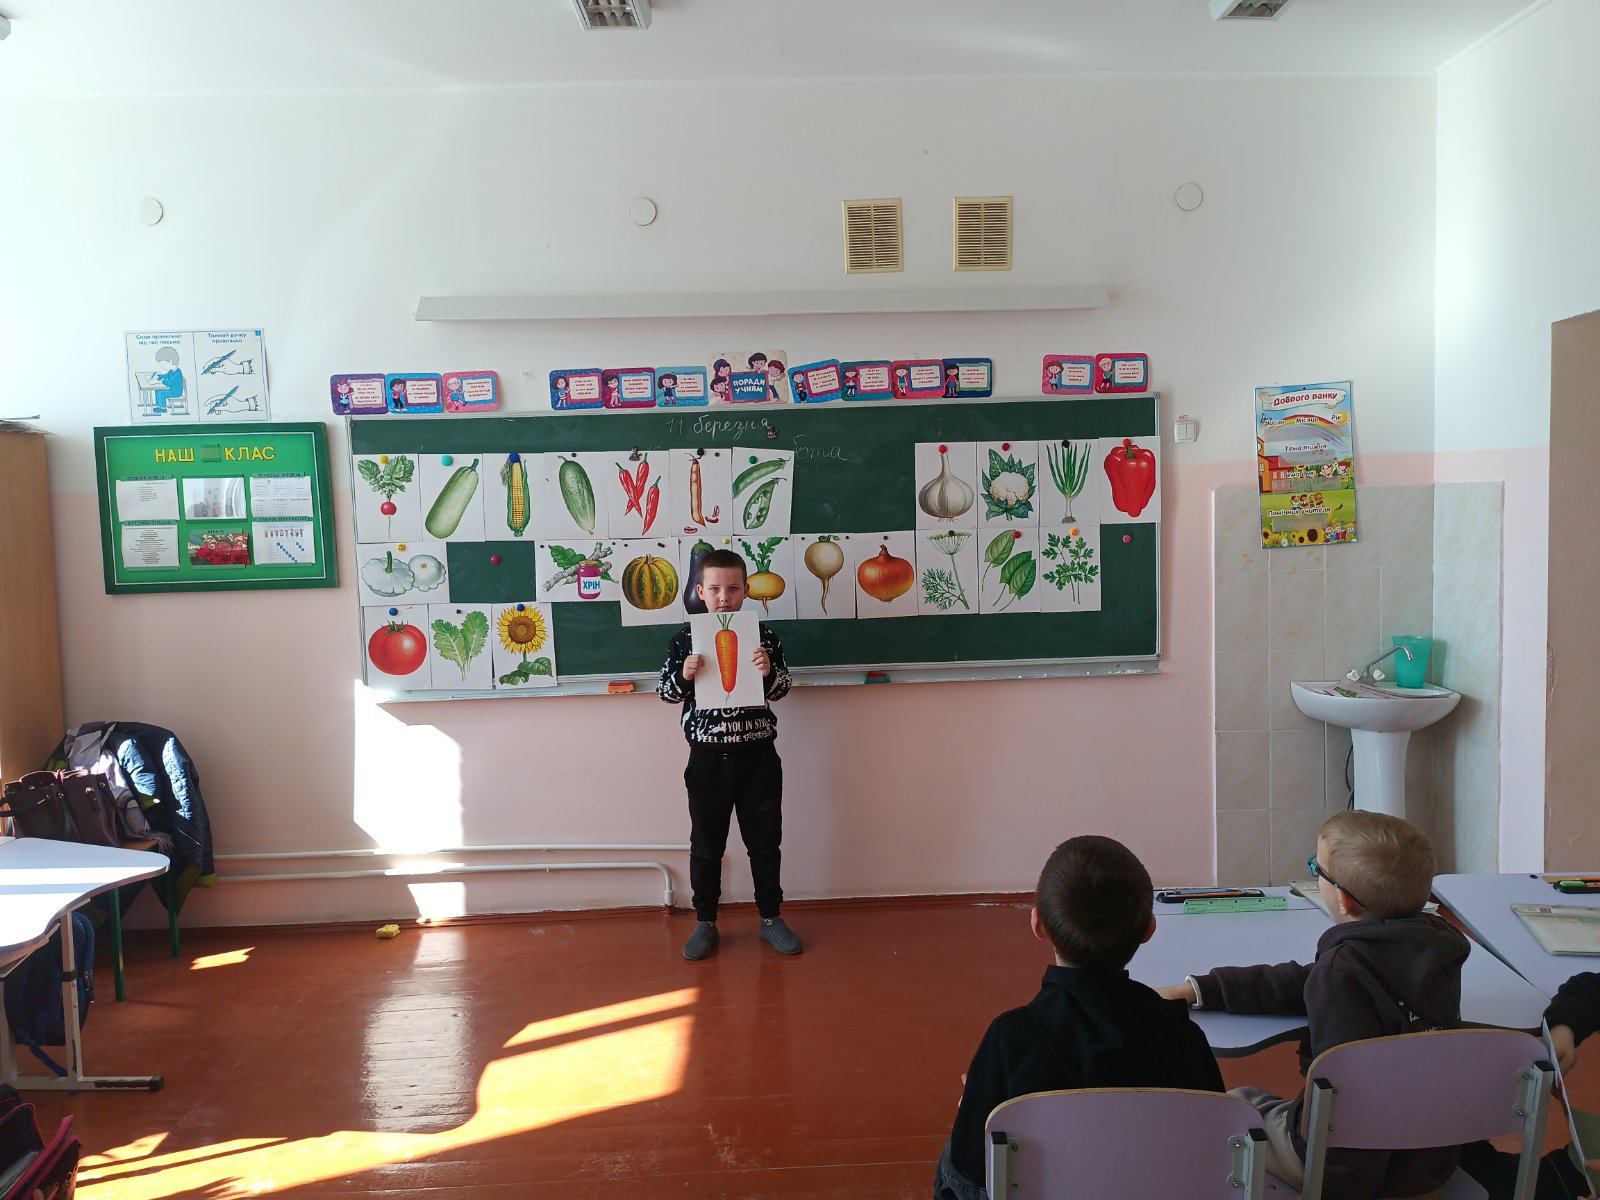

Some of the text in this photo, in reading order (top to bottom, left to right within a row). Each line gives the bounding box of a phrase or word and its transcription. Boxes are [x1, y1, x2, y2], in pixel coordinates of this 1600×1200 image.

[732, 378, 765, 387] ПОРАДИ
[735, 386, 763, 394] УЧНЯМ
[1273, 392, 1338, 406] Доброго ранку
[666, 418, 682, 434] 11
[155, 446, 275, 462] НАШ КЛАС
[582, 580, 601, 590] ХРІН
[727, 722, 743, 732] YOU
[745, 721, 753, 731] IN
[698, 734, 719, 743] FEEL
[721, 734, 741, 743] THE
